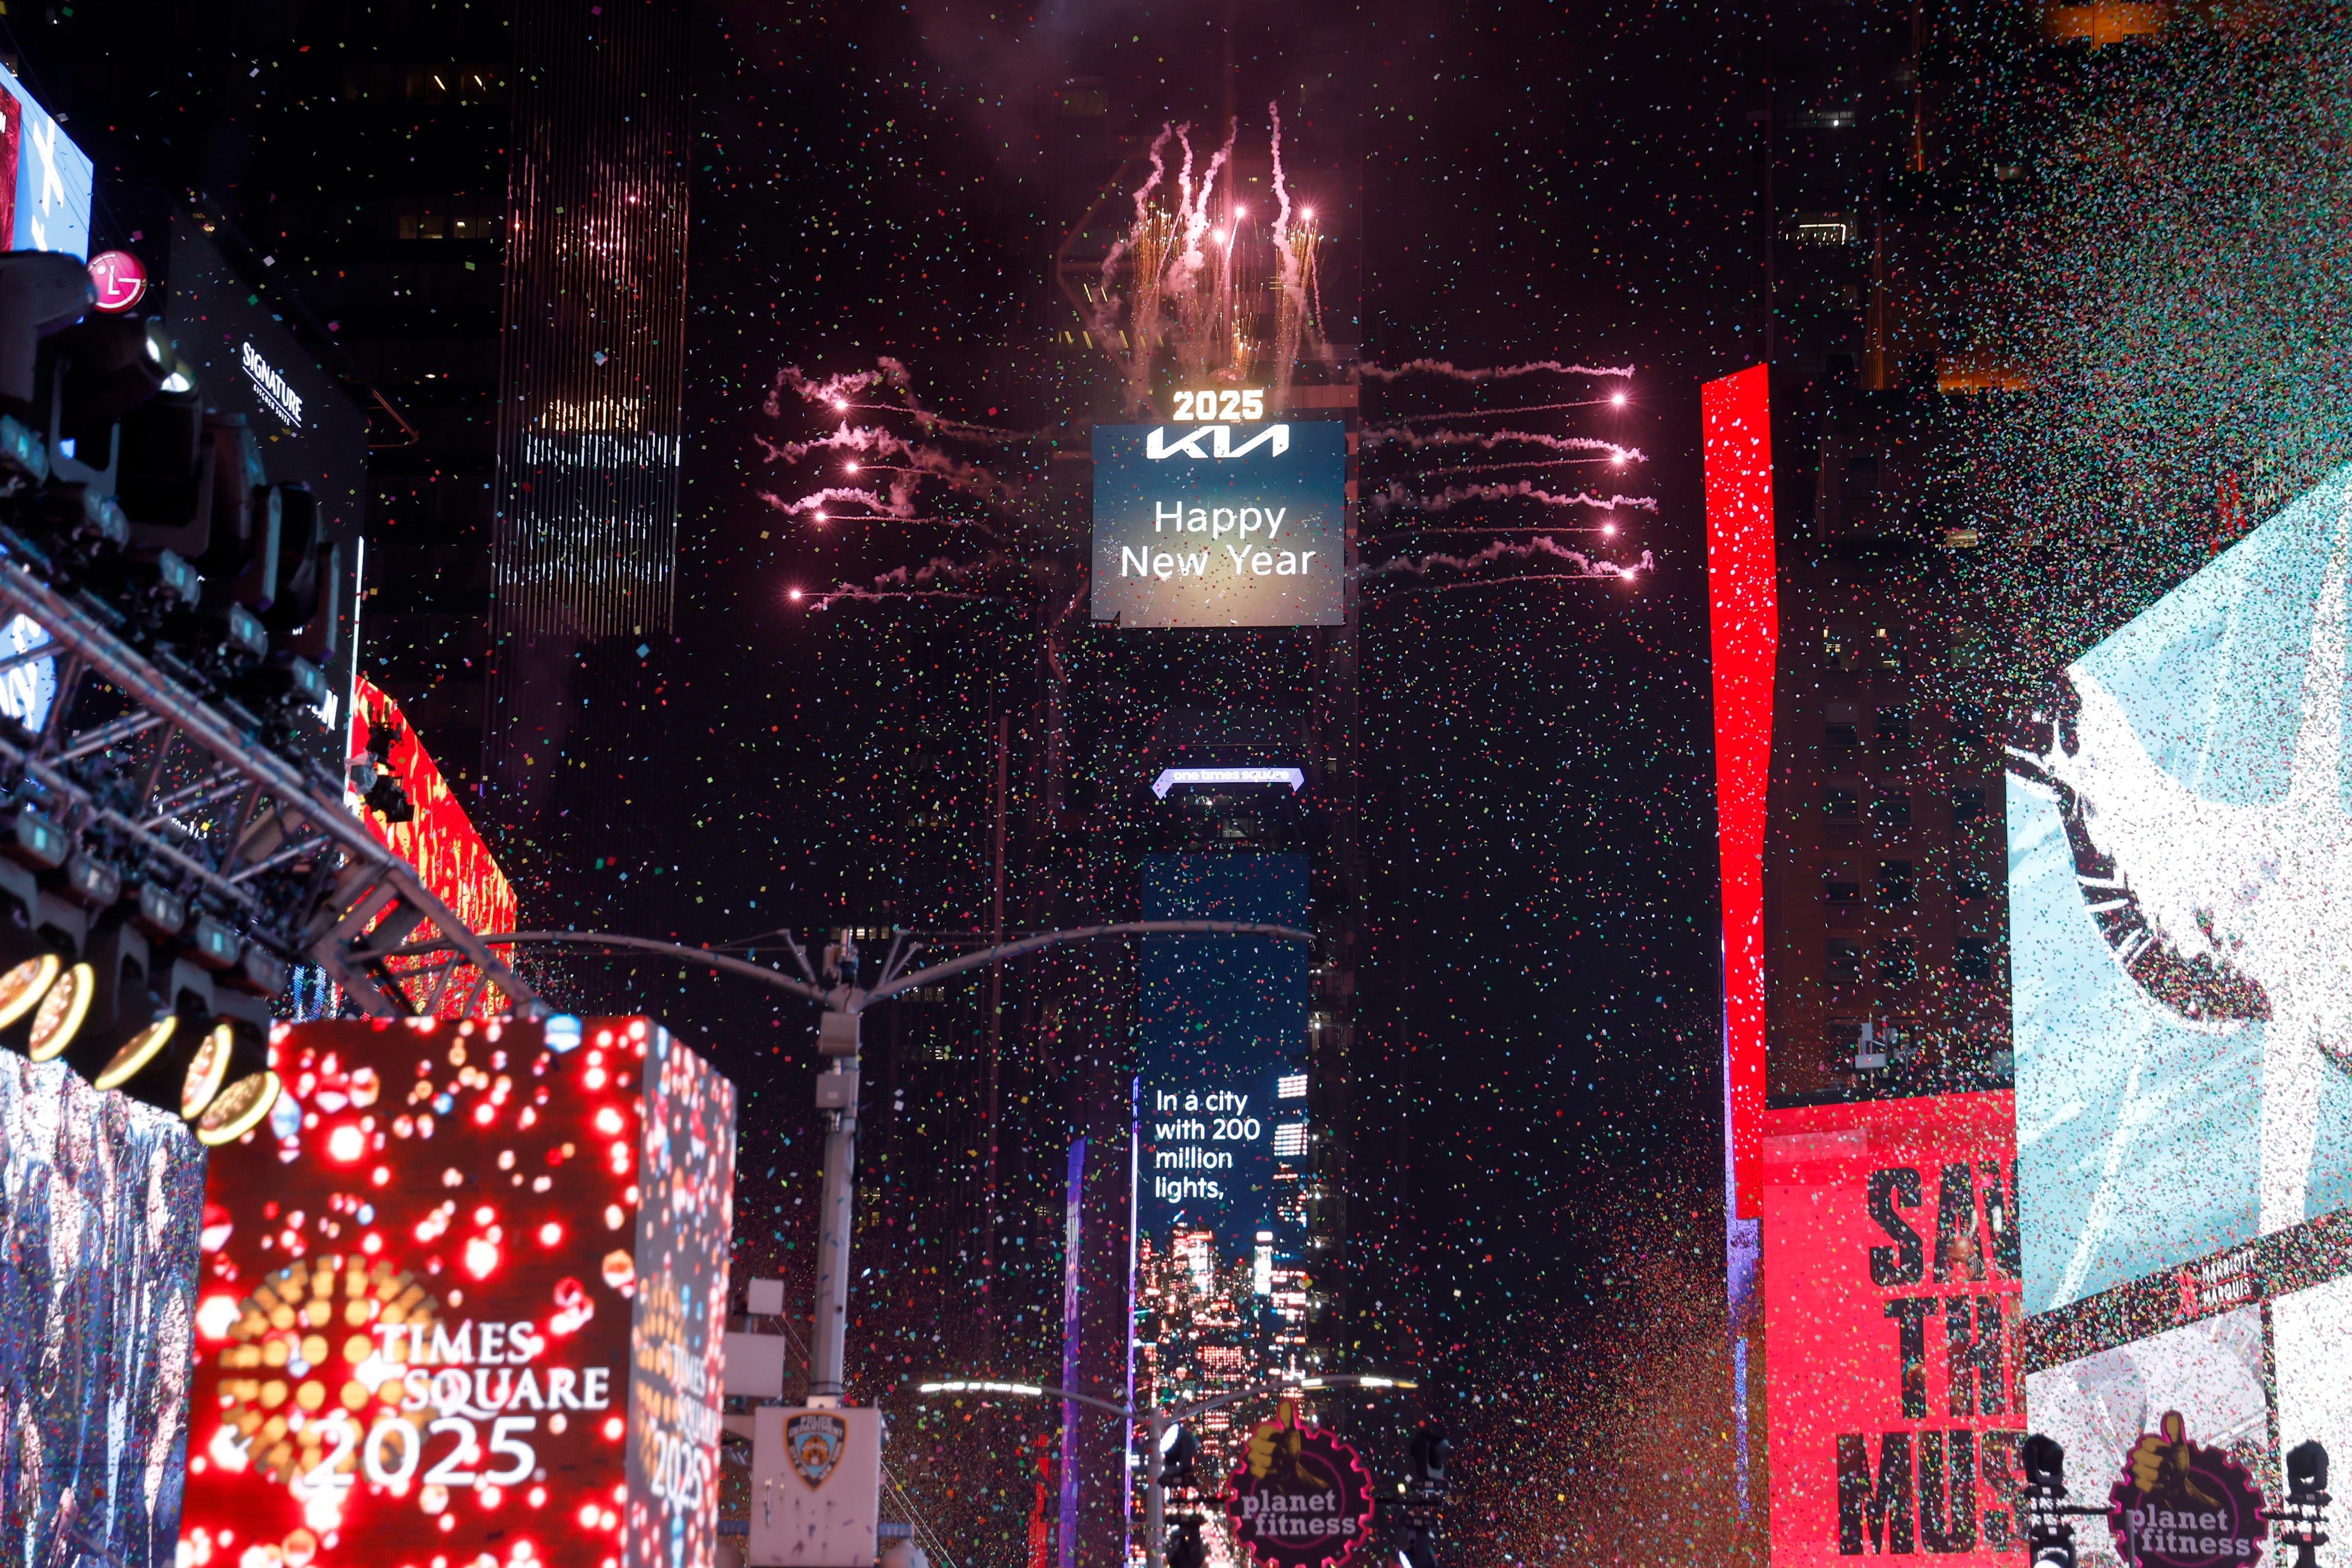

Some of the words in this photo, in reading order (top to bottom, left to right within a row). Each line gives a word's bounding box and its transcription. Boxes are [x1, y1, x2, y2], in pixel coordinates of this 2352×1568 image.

[88, 254, 142, 309] LG
[243, 341, 303, 422] SIGNATURE
[254, 384, 275, 410] KITCHEN
[276, 406, 290, 426] SUITE
[1173, 390, 1263, 420] 2025
[1146, 425, 1289, 459] KIA
[1156, 501, 1286, 540] Happy
[1122, 546, 1208, 577] New
[1226, 544, 1316, 575] Year
[1174, 770, 1199, 781] one
[1201, 770, 1240, 780] times
[1241, 771, 1290, 783] square
[1157, 1089, 1177, 1111] In
[1184, 1094, 1198, 1111] a
[1206, 1090, 1248, 1116] city
[1156, 1118, 1205, 1140] with
[1212, 1118, 1260, 1140] 200
[1156, 1146, 1233, 1169] million
[1155, 1175, 1224, 1203] lights,
[2203, 1277, 2251, 1307] MARQUIS
[372, 1321, 535, 1365] TIMES
[401, 1367, 610, 1420] SQUARE
[800, 1414, 833, 1425] POLICE
[303, 1415, 537, 1486] 2025
[650, 1430, 703, 1511] 2025
[1242, 1489, 1336, 1519] planet
[2126, 1503, 2228, 1534] planet
[1255, 1512, 1356, 1535] fitness
[2141, 1528, 2251, 1556] fitness
